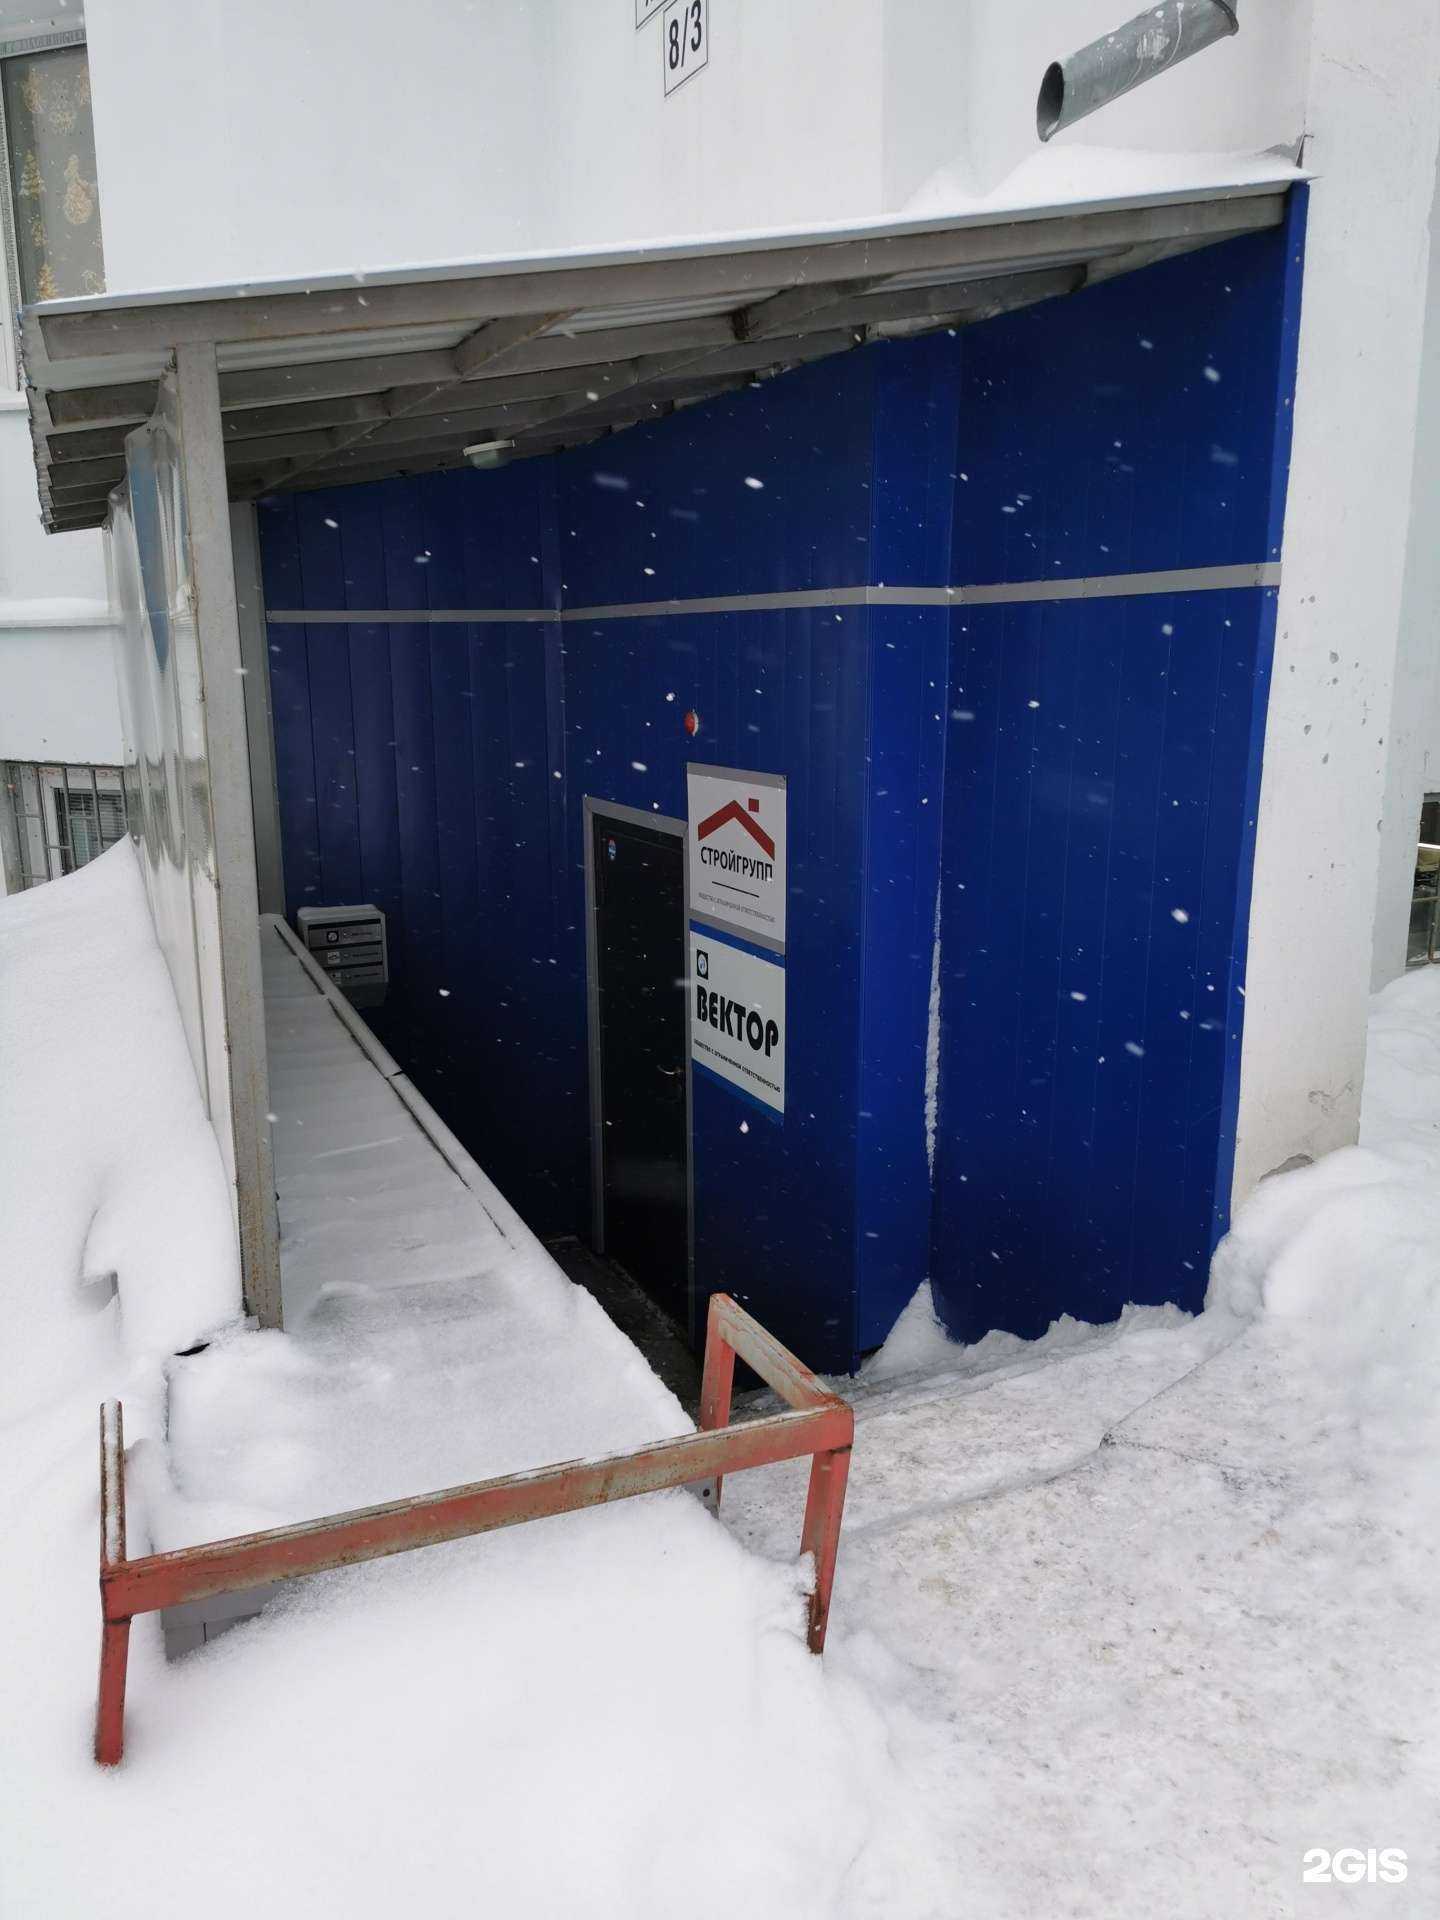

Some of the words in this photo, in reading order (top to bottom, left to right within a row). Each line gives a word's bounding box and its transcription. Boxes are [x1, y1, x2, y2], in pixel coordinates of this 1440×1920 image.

[669, 0, 702, 70] 8/3
[700, 846, 773, 881] СТРОЙГРУПП
[696, 984, 779, 1057] ВЕКТОР
